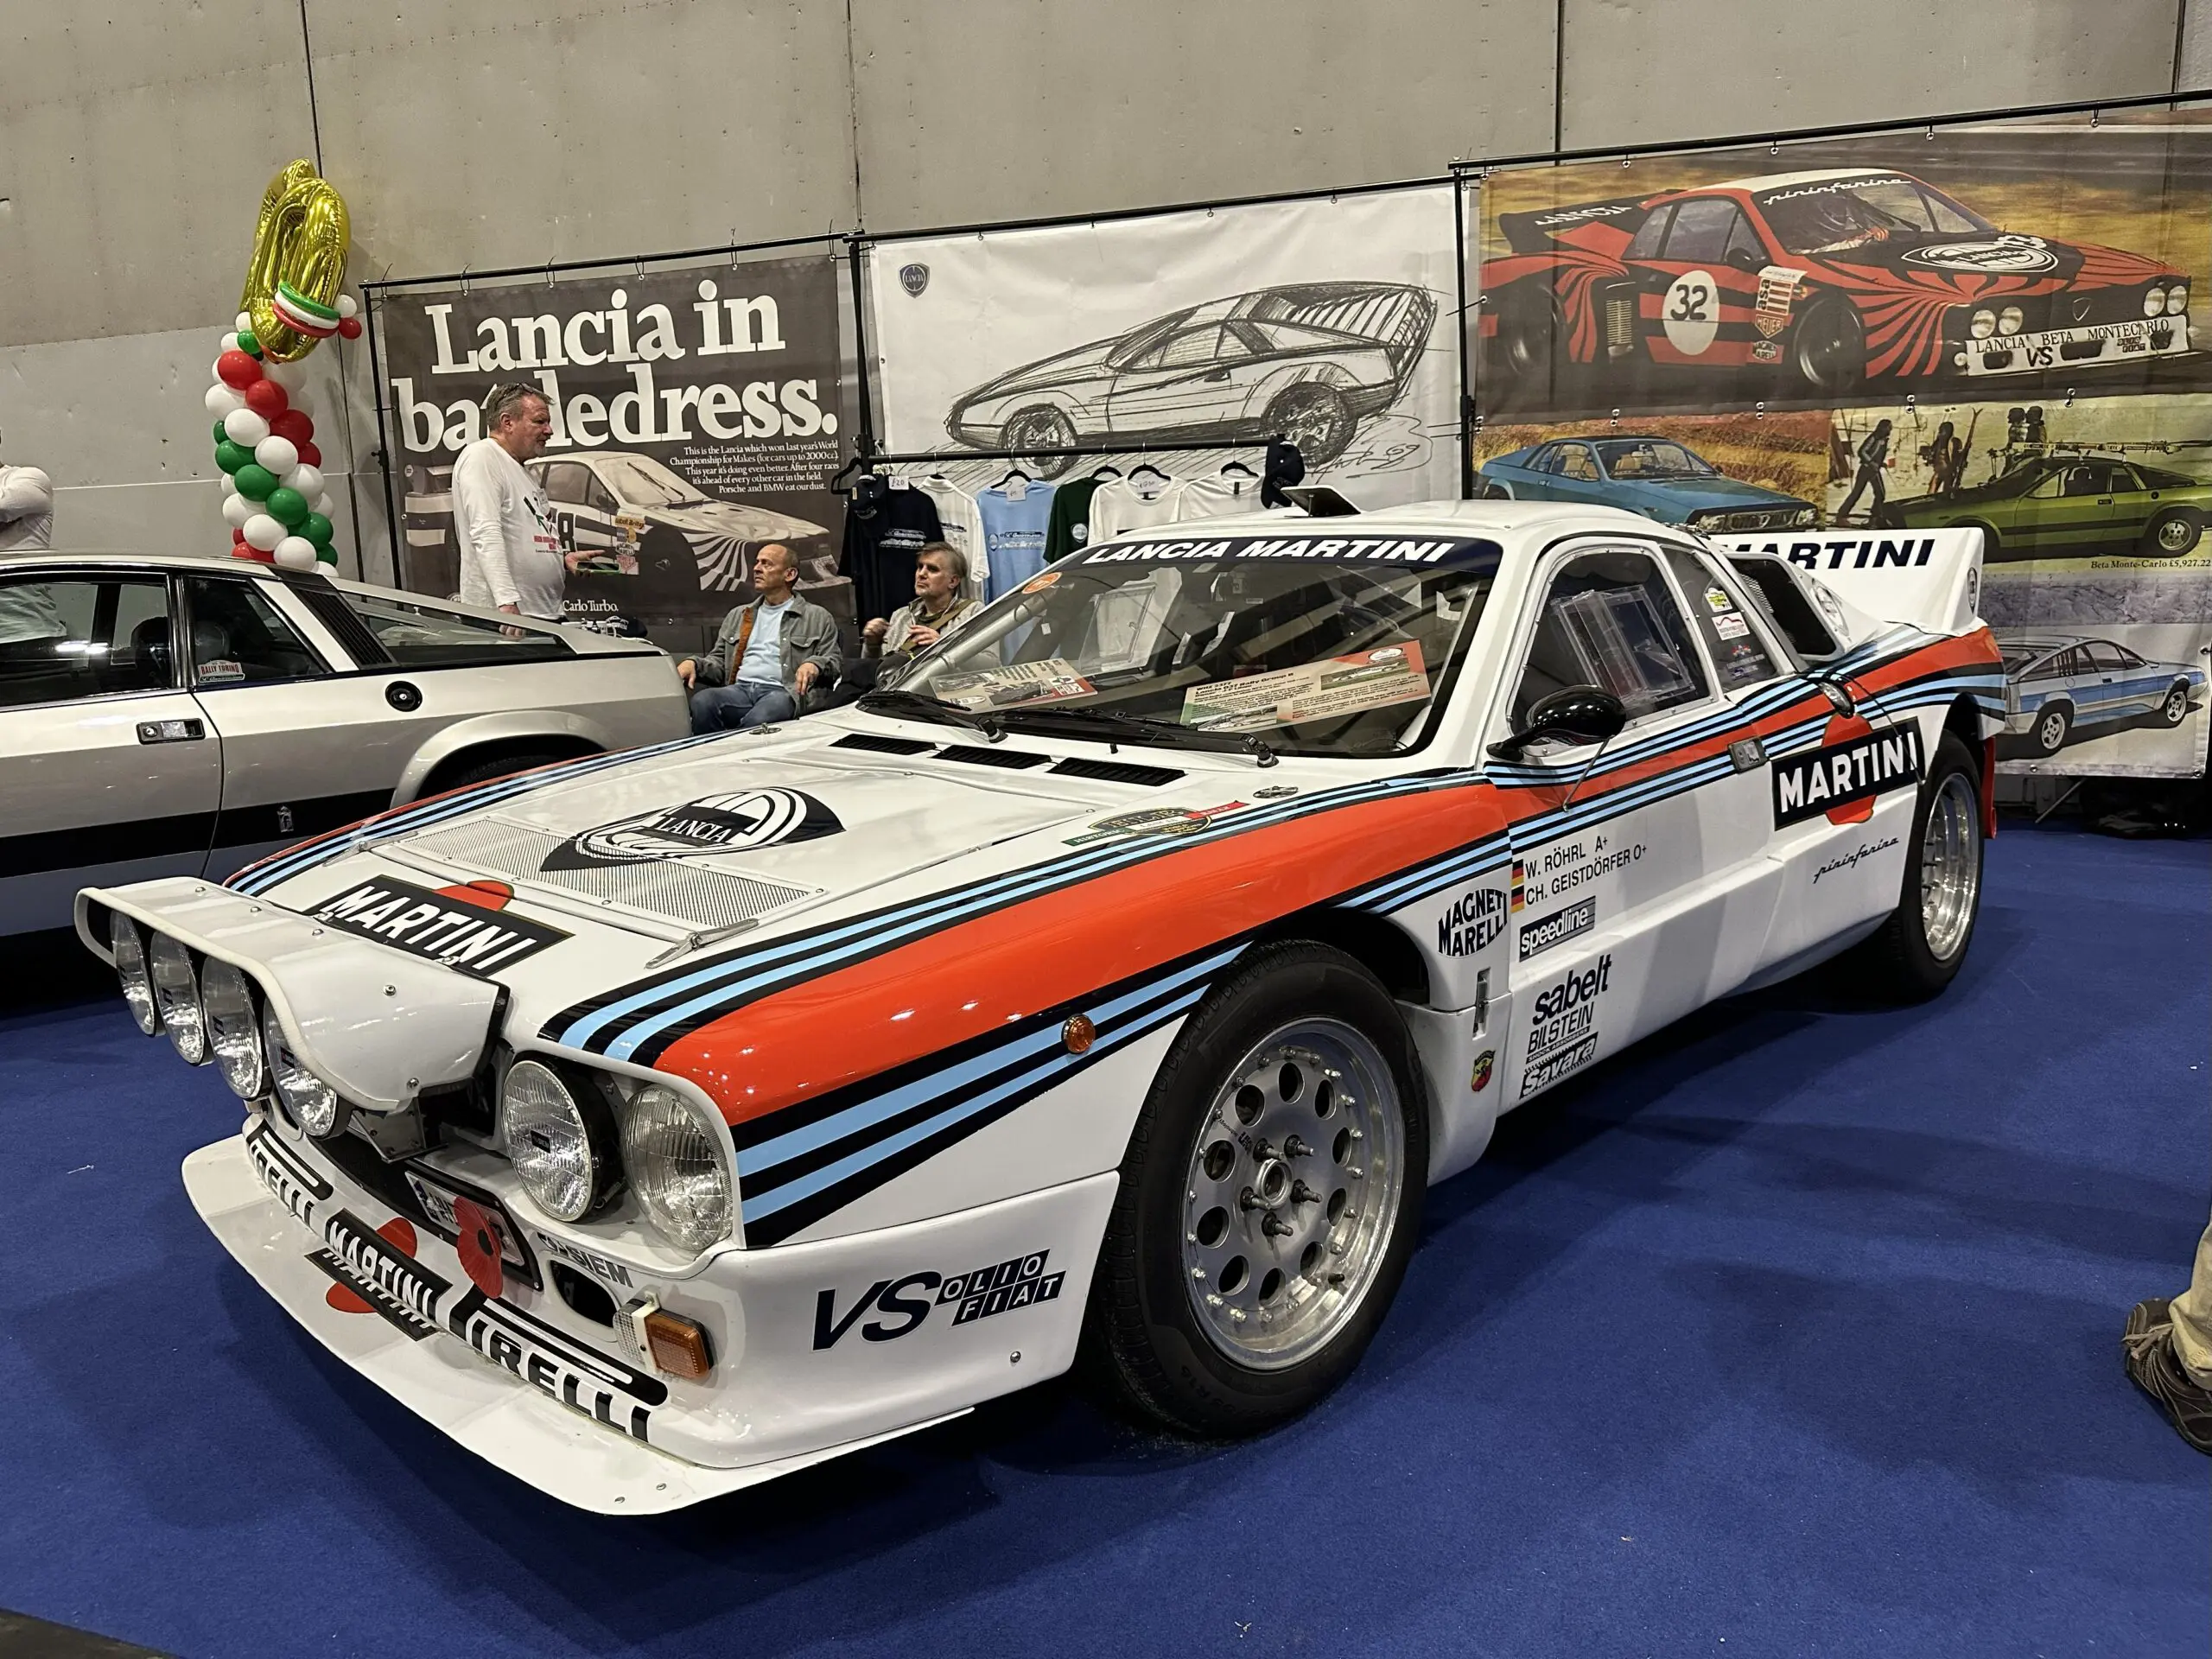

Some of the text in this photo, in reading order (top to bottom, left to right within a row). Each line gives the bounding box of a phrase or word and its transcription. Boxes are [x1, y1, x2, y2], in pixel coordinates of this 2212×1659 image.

[1764, 176, 1912, 206] pininfarina
[1670, 283, 1708, 321] 32
[1758, 278, 1771, 311] asa
[424, 279, 785, 375] Lancia in
[1975, 336, 2027, 353] LANCIA
[2042, 330, 2075, 346] BETA
[2026, 346, 2054, 368] VS
[670, 454, 722, 467] Championship
[723, 454, 733, 463] for
[733, 454, 756, 463] Makes
[771, 454, 786, 462] cars
[786, 454, 797, 464] up
[684, 446, 700, 455] This
[708, 446, 720, 454] the
[721, 445, 743, 454] Lancia
[744, 443, 766, 453] which
[785, 442, 798, 451] last
[818, 440, 838, 449] World
[685, 466, 702, 475] This
[702, 467, 717, 477] year
[728, 466, 747, 476] doing
[790, 461, 808, 471] After
[809, 461, 823, 470] four
[702, 475, 722, 484] ahead
[723, 474, 731, 483] of
[732, 475, 750, 485] every
[752, 473, 772, 482] other
[794, 472, 805, 480] the
[719, 484, 747, 493] Porsche
[747, 483, 762, 492] and
[764, 483, 785, 492] BMW
[810, 480, 826, 490] dust.
[1082, 539, 1457, 564] LANCIA MARTINI
[2110, 559, 2167, 569] Monte-Carlo
[2169, 559, 2211, 569] £5,927.22
[563, 599, 619, 613] Carlo Turbo.
[1779, 731, 1917, 813] MARTINI
[657, 815, 732, 844] LANCIA
[1525, 836, 1608, 880] W. RÖHRL A+
[1526, 843, 1647, 906] CH. GEISTDÖRFER O+
[1813, 836, 1899, 885] pininfarina
[320, 885, 537, 970] MARTINI
[1438, 888, 1508, 934] MAGNETI
[1438, 914, 1508, 957] MARELLI
[1520, 906, 1588, 955] speedline
[1532, 954, 1612, 1026] sabelt
[1527, 1001, 1594, 1055] BILSTEIN
[1527, 1027, 1589, 1063] SHOCK ABSORBERS
[942, 1255, 1044, 1300] OLIO
[812, 1270, 944, 1352] VS
[959, 1275, 1061, 1321] FIAT
